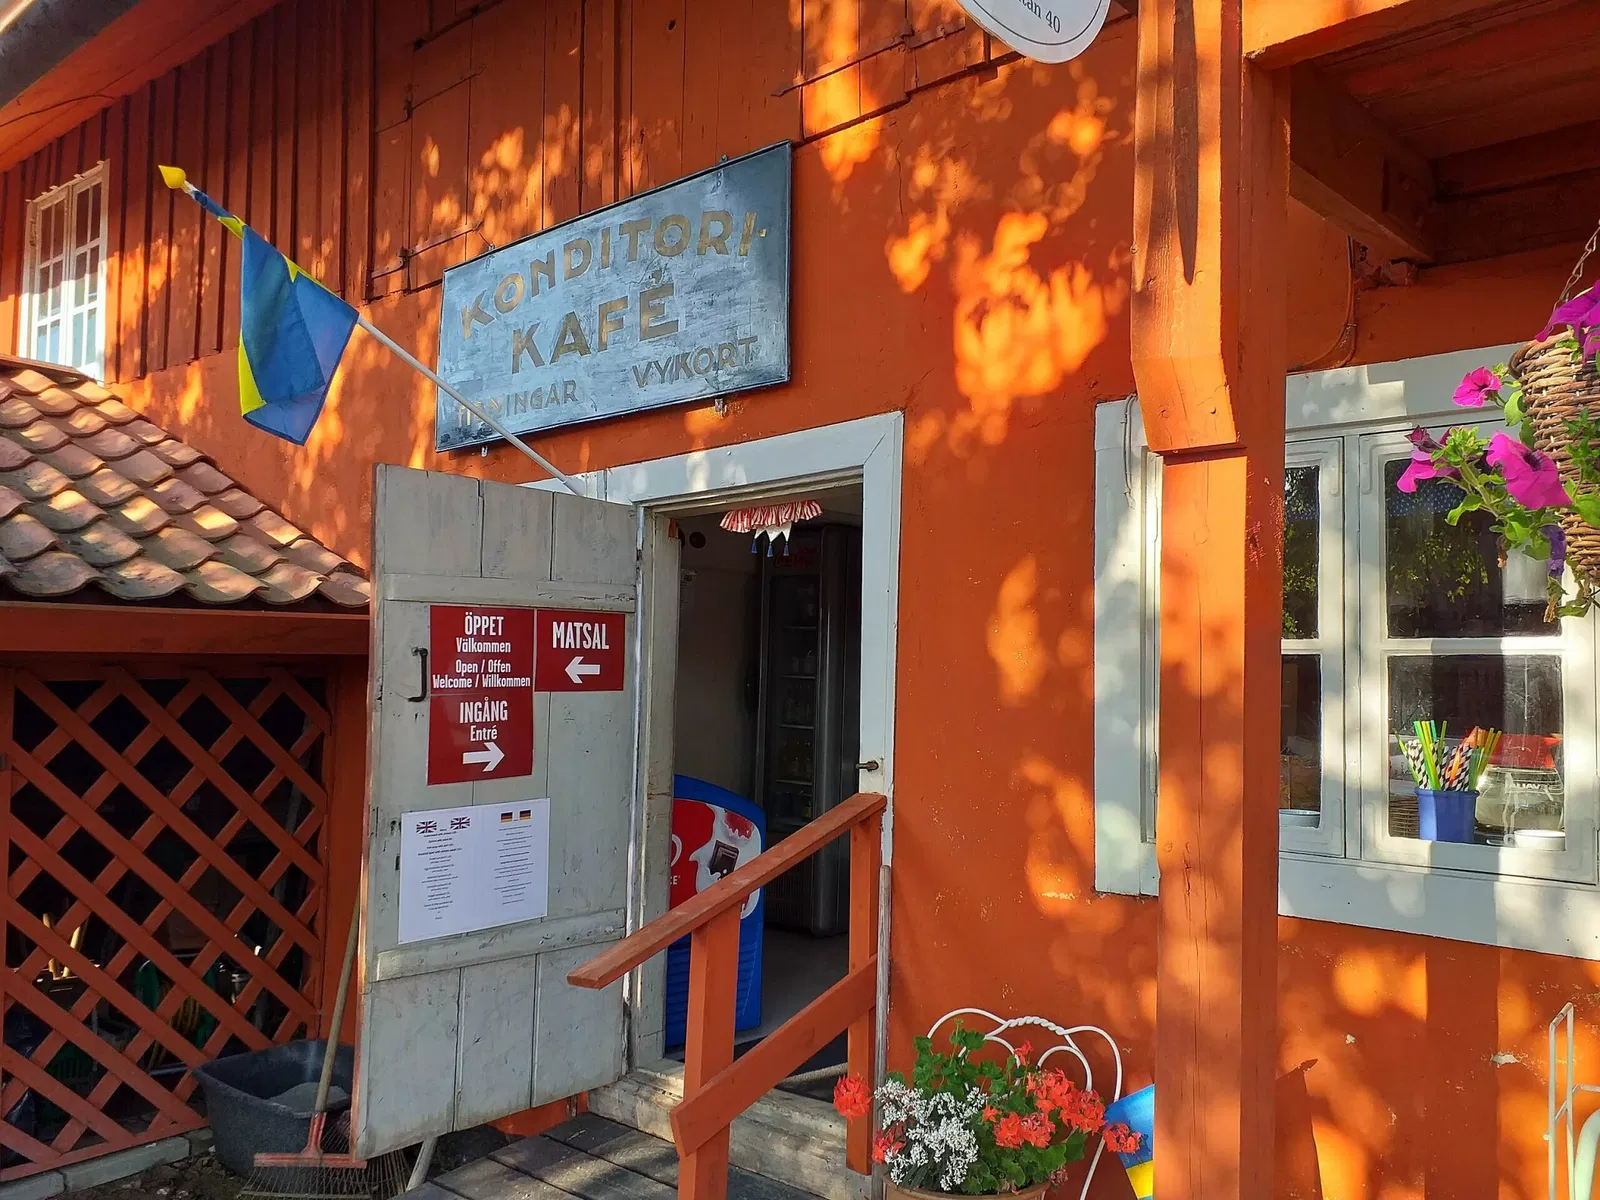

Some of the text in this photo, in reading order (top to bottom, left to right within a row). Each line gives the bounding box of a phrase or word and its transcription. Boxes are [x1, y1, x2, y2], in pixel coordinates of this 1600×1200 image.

[1045, 10, 1061, 33] 40
[512, 270, 679, 374] KAFÉ
[632, 336, 759, 389] VYKORT
[464, 612, 504, 636] ÖPPET
[552, 621, 610, 650] MATSAL
[456, 637, 511, 653] Välkommen
[455, 660, 511, 676] Open / Offen
[432, 674, 531, 689] Welcome / Willkommen
[459, 696, 508, 724] INGÅNG
[470, 724, 498, 742] Entré
